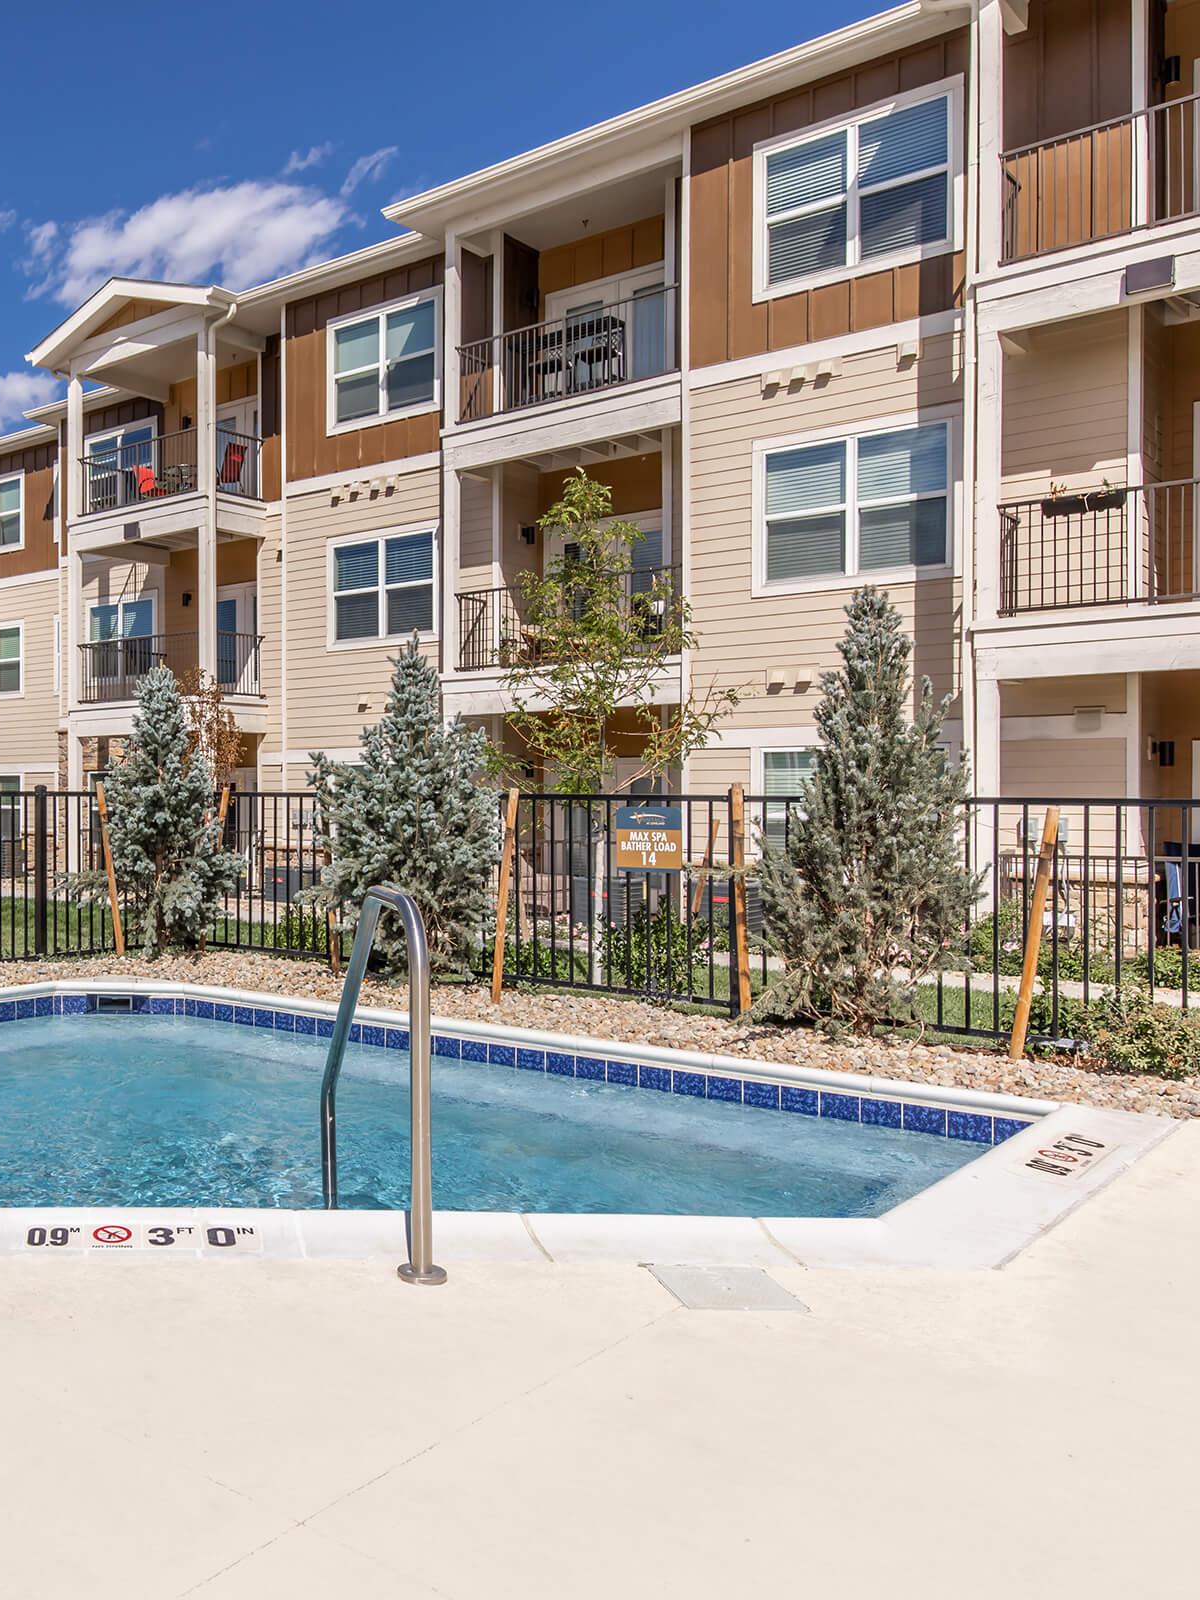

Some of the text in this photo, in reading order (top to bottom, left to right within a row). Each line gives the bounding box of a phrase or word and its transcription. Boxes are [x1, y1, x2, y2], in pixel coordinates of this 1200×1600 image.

[629, 831, 668, 842] MAX SPA
[621, 841, 677, 853] BATHER LOAD
[641, 852, 657, 866] 14
